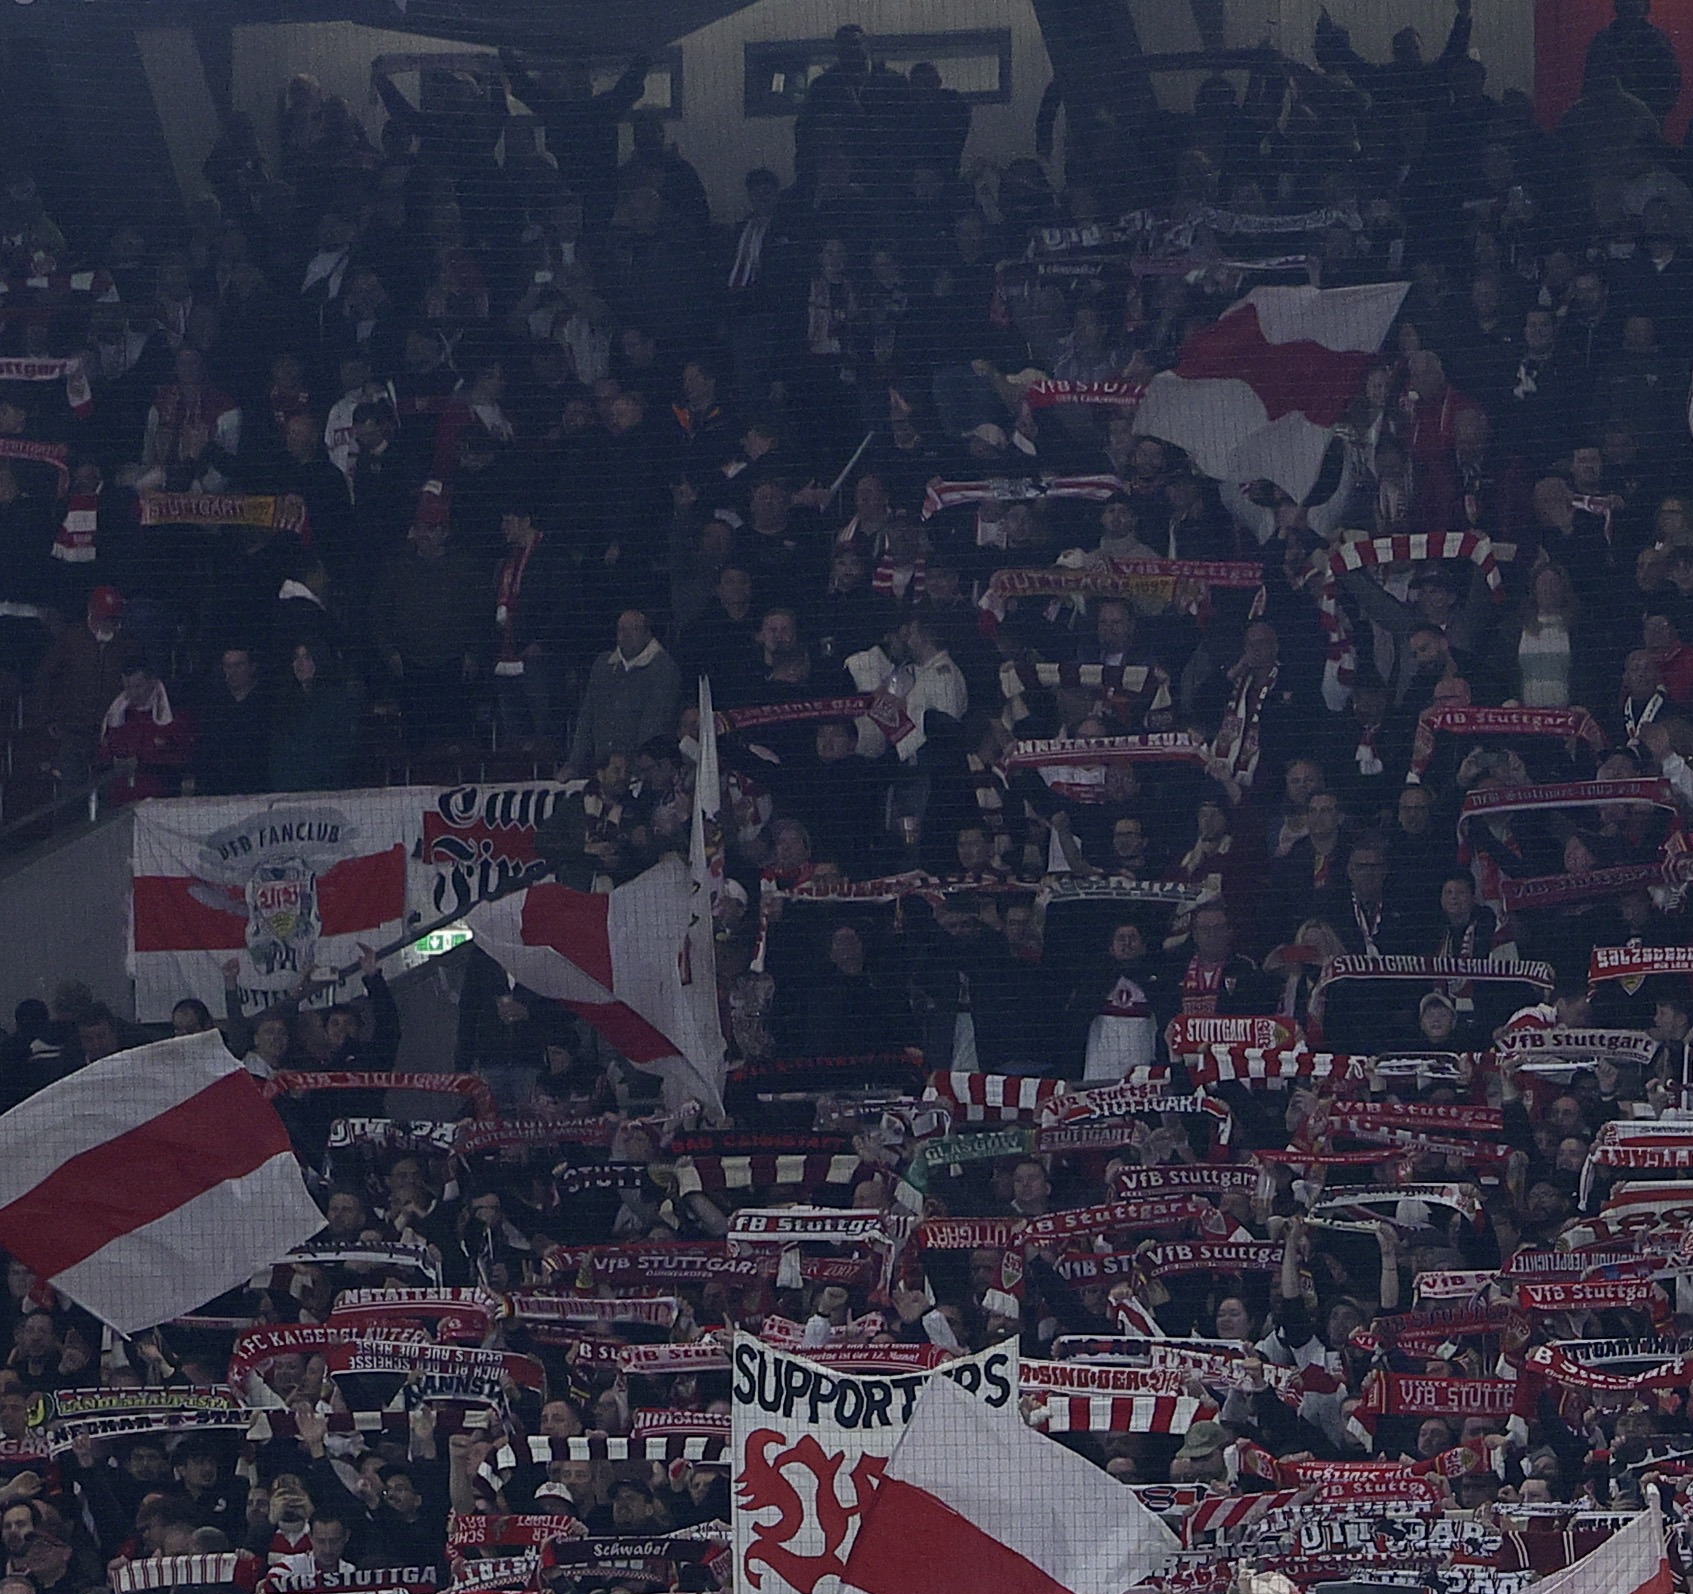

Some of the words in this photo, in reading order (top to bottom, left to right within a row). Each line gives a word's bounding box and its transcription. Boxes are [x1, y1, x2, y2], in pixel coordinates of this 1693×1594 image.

[258, 822, 341, 849] FANCLUB
[1187, 1017, 1252, 1041] STUTTGART
[1551, 1032, 1652, 1051] Stuttgart
[1121, 1172, 1162, 1188] VfB
[735, 1342, 1011, 1428] SUPPORTRS
